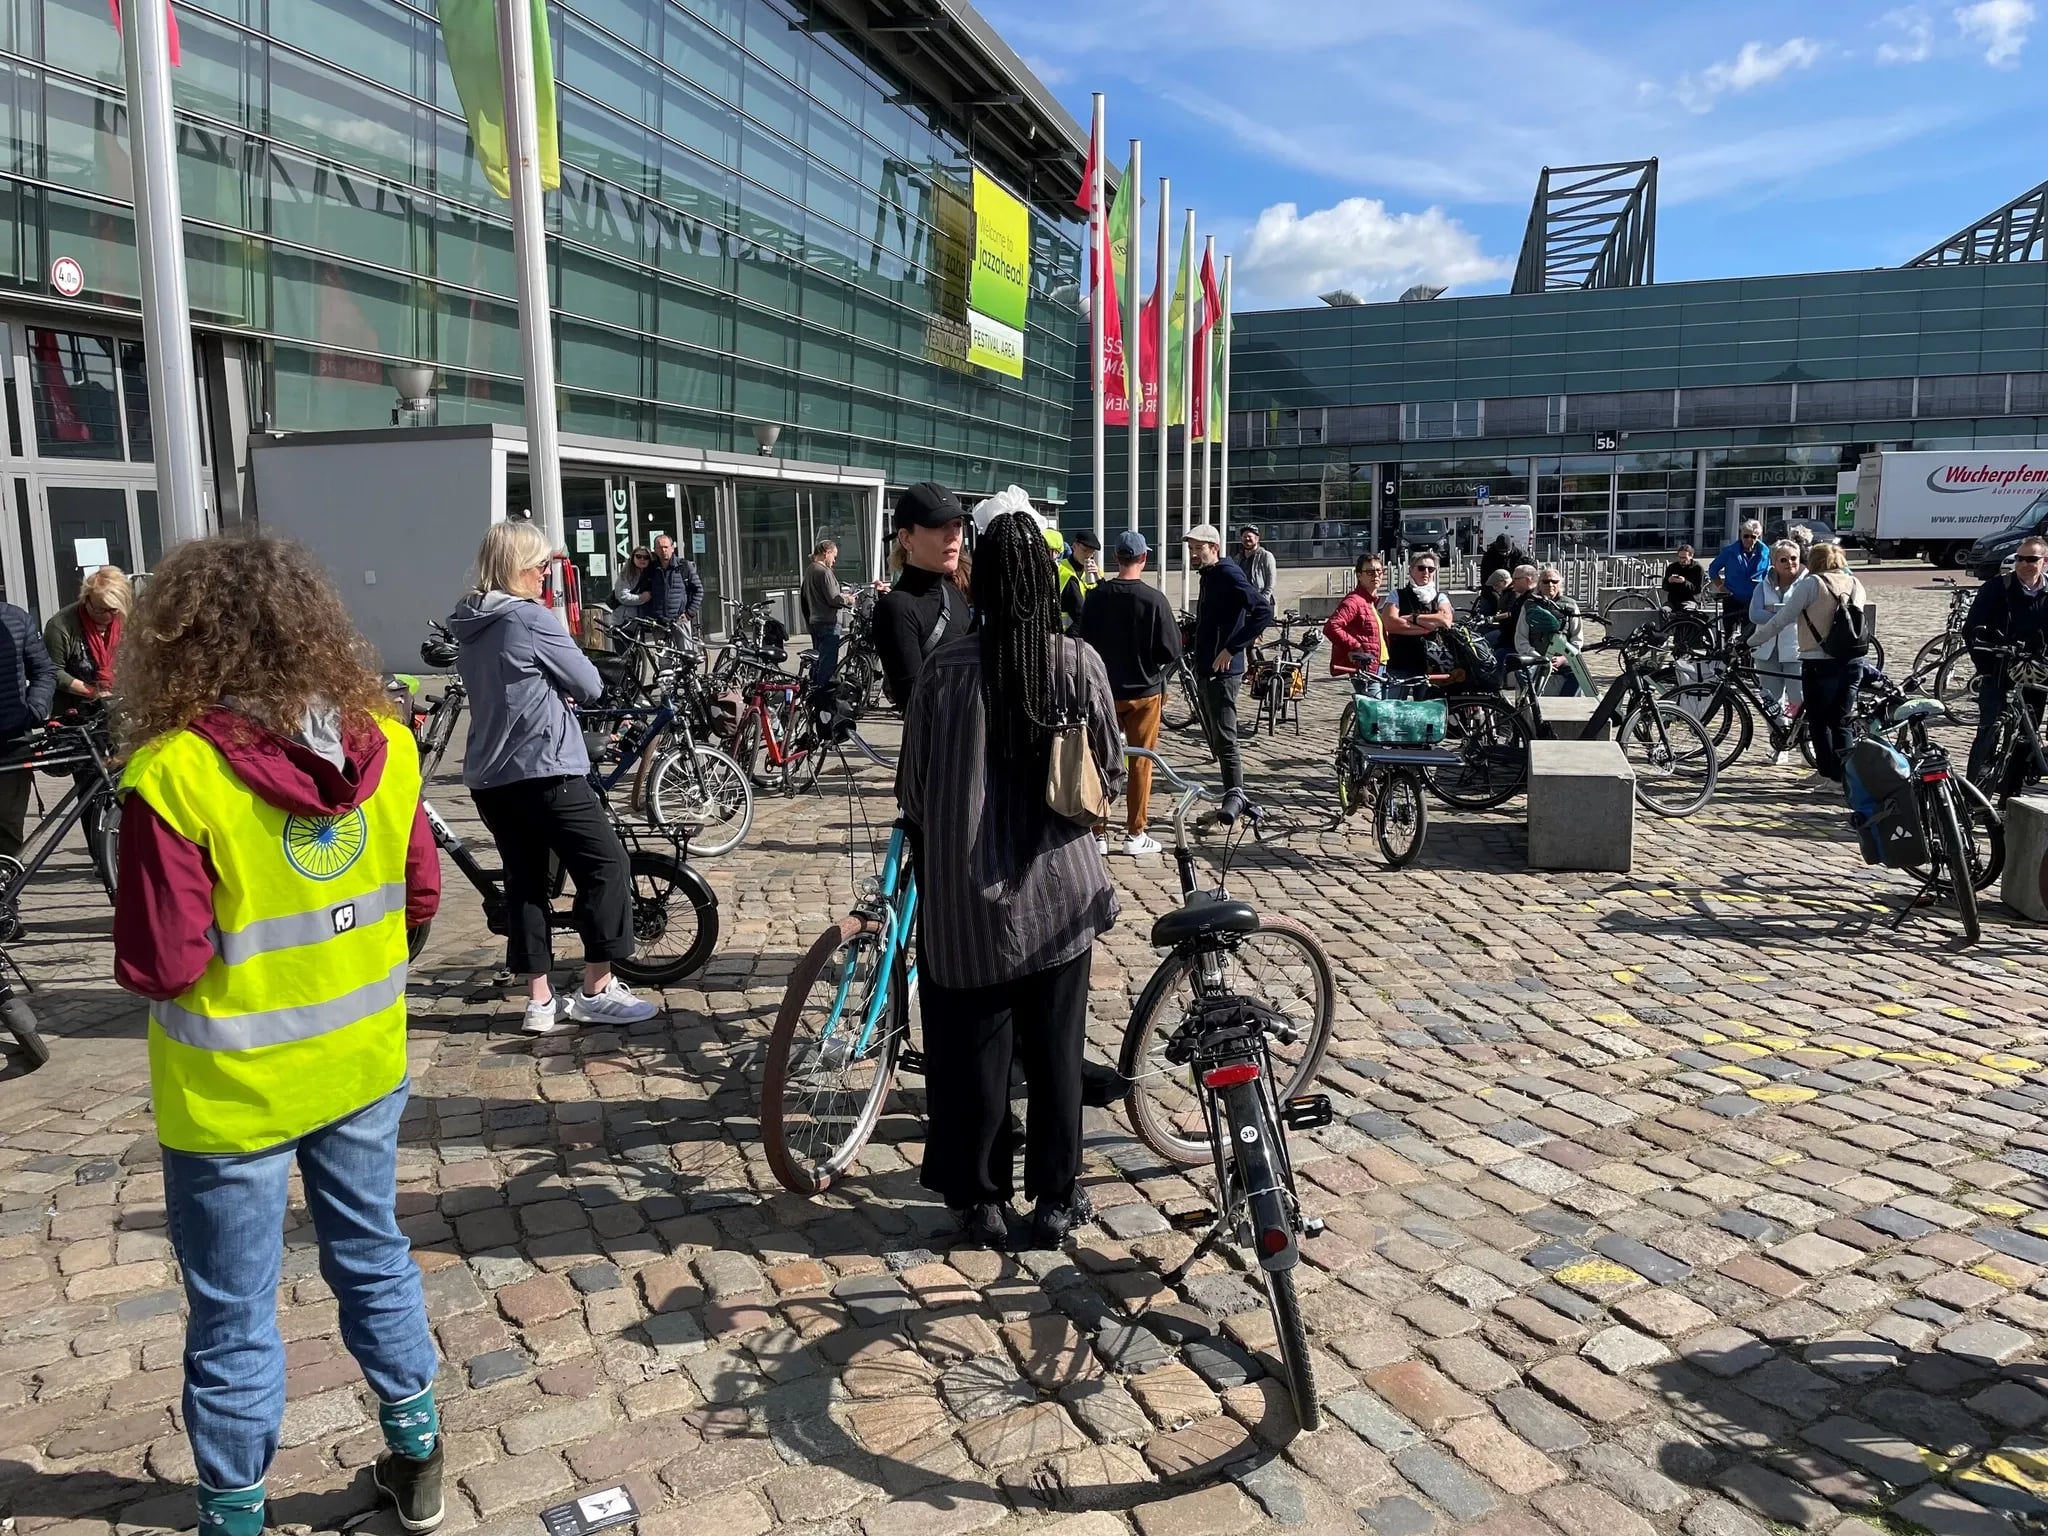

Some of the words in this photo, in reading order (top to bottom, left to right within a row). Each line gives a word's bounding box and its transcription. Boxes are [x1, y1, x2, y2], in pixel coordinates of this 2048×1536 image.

[979, 215, 1006, 249] Welcome
[1007, 237, 1014, 252] to
[978, 240, 1024, 287] jazzahead!
[973, 329, 1000, 354] FESTIVAL
[1001, 339, 1016, 358] AREA
[1597, 437, 1616, 450] 5b
[1751, 470, 1817, 483] EINGANG
[1385, 481, 1395, 495] 5
[1479, 487, 1487, 497] P
[1383, 500, 1394, 528] Halle
[613, 489, 631, 573] ANG
[1242, 1129, 1256, 1139] 39
